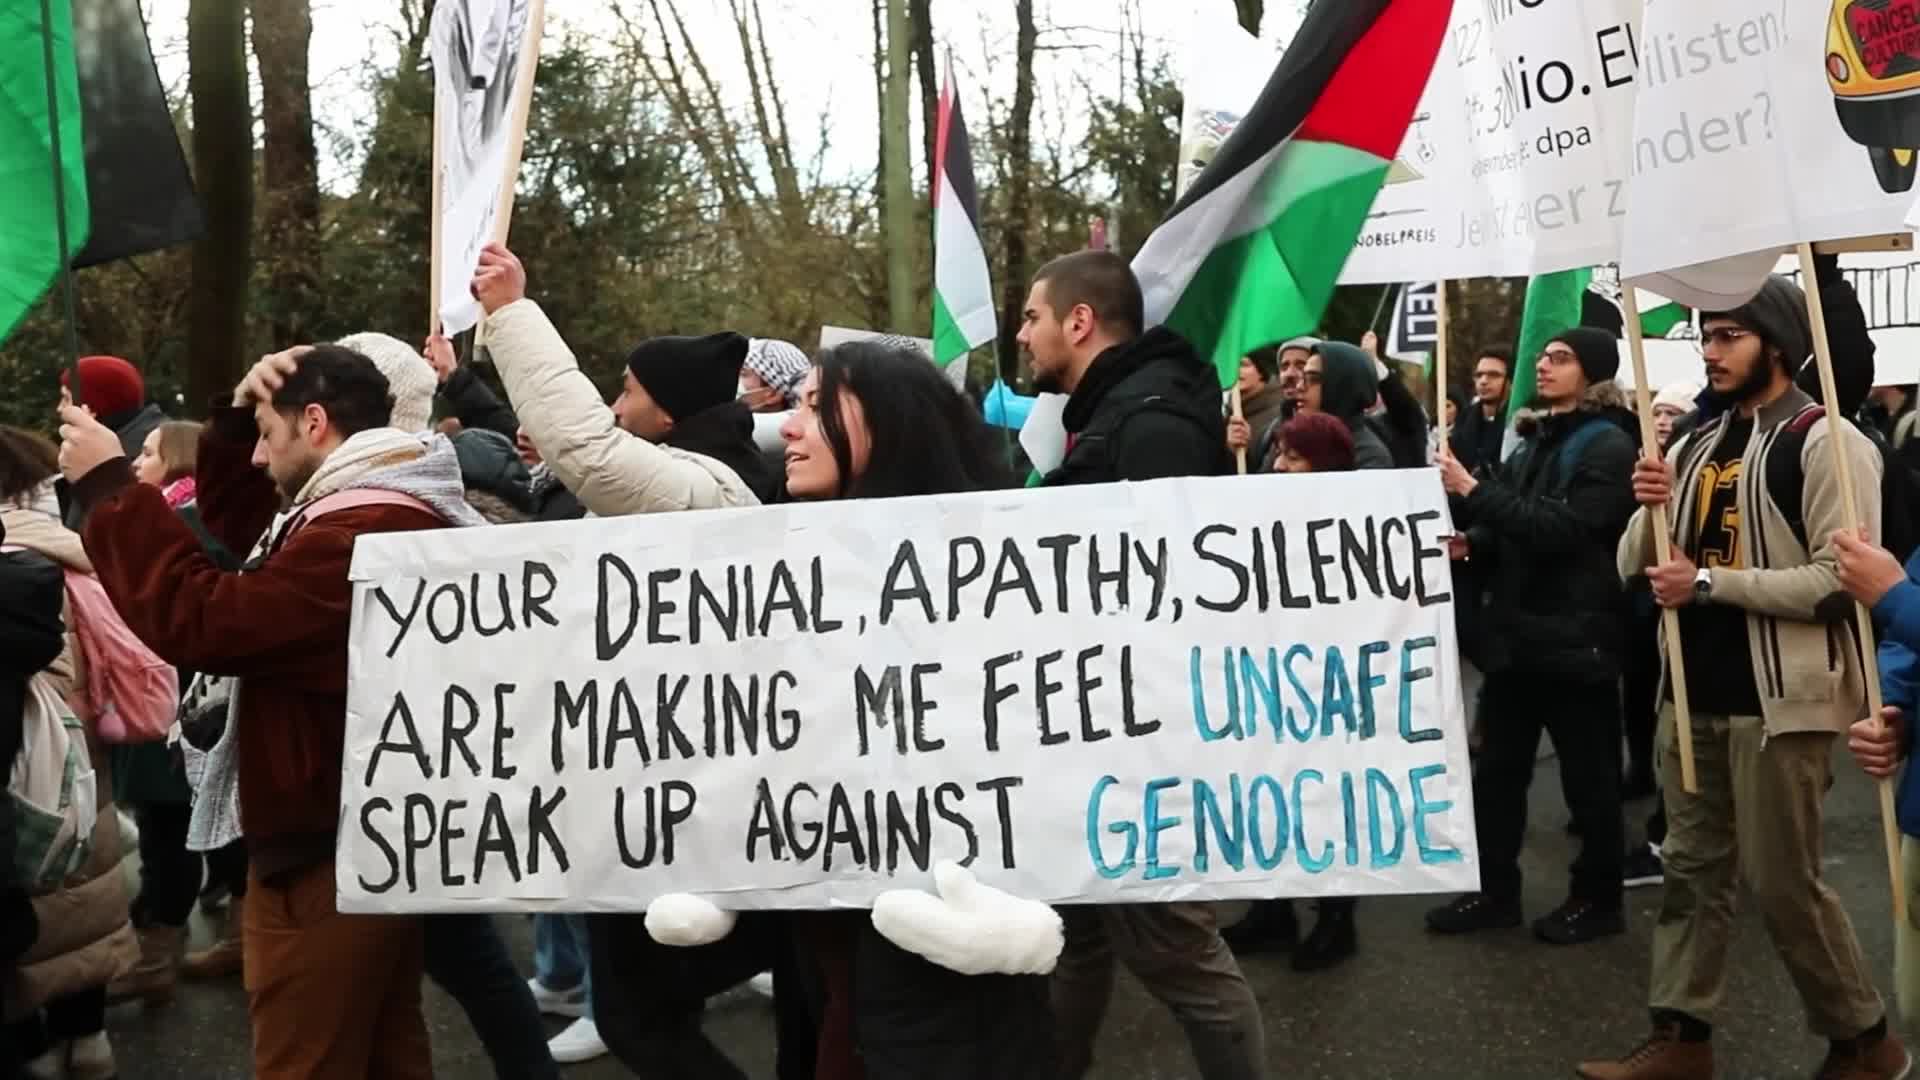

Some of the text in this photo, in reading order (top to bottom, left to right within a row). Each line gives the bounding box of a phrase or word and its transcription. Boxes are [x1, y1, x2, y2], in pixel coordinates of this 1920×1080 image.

[1536, 126, 1592, 157] dpa
[373, 509, 1452, 661] YOUR DENIAL, APATHY, SILENCE
[364, 636, 1444, 787] ARE MAKING ME FEEL UNSAFE
[357, 762, 1464, 894] SPEAK UP AGAINST GENOCIDE
